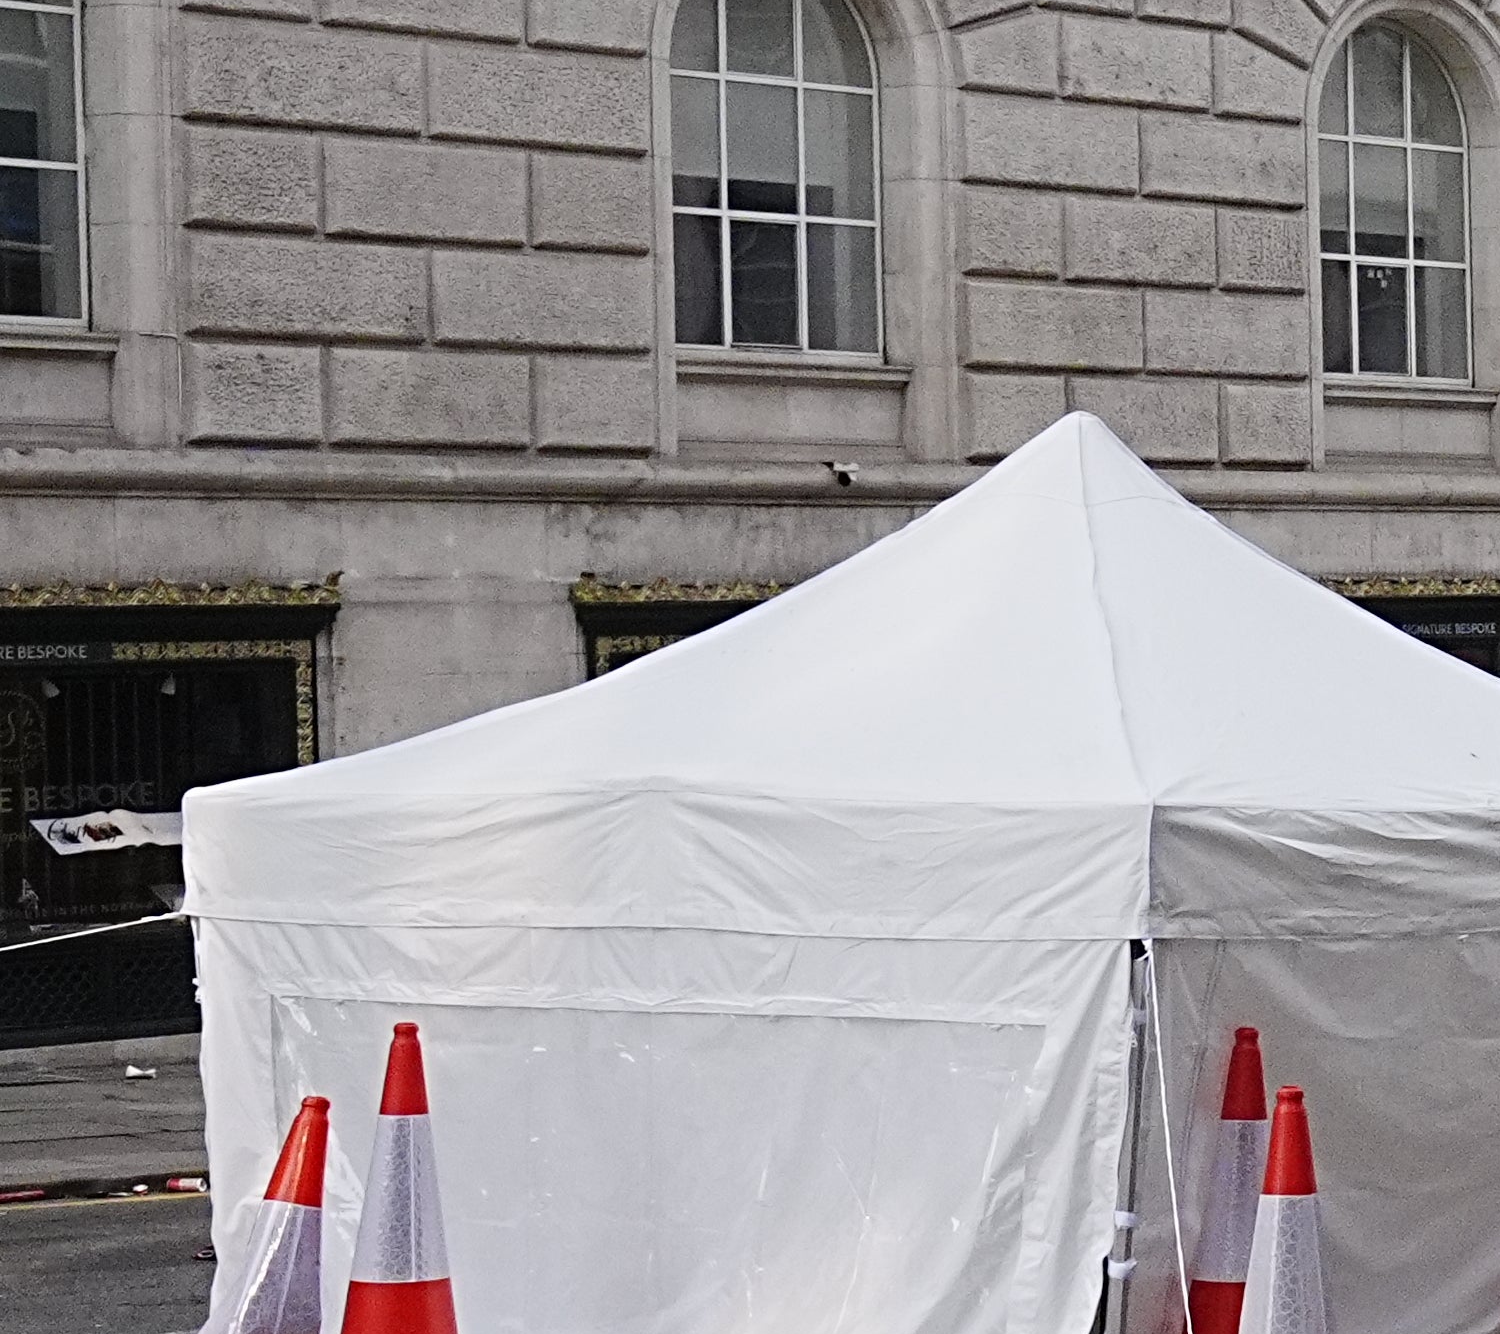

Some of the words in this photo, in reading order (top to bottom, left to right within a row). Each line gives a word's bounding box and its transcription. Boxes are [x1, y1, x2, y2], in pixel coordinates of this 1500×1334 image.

[1402, 623, 1452, 636] SIGNATURE
[1454, 622, 1497, 635] BESPOKE
[17, 644, 89, 660] BESPOKE
[24, 782, 155, 812] BESPOKE
